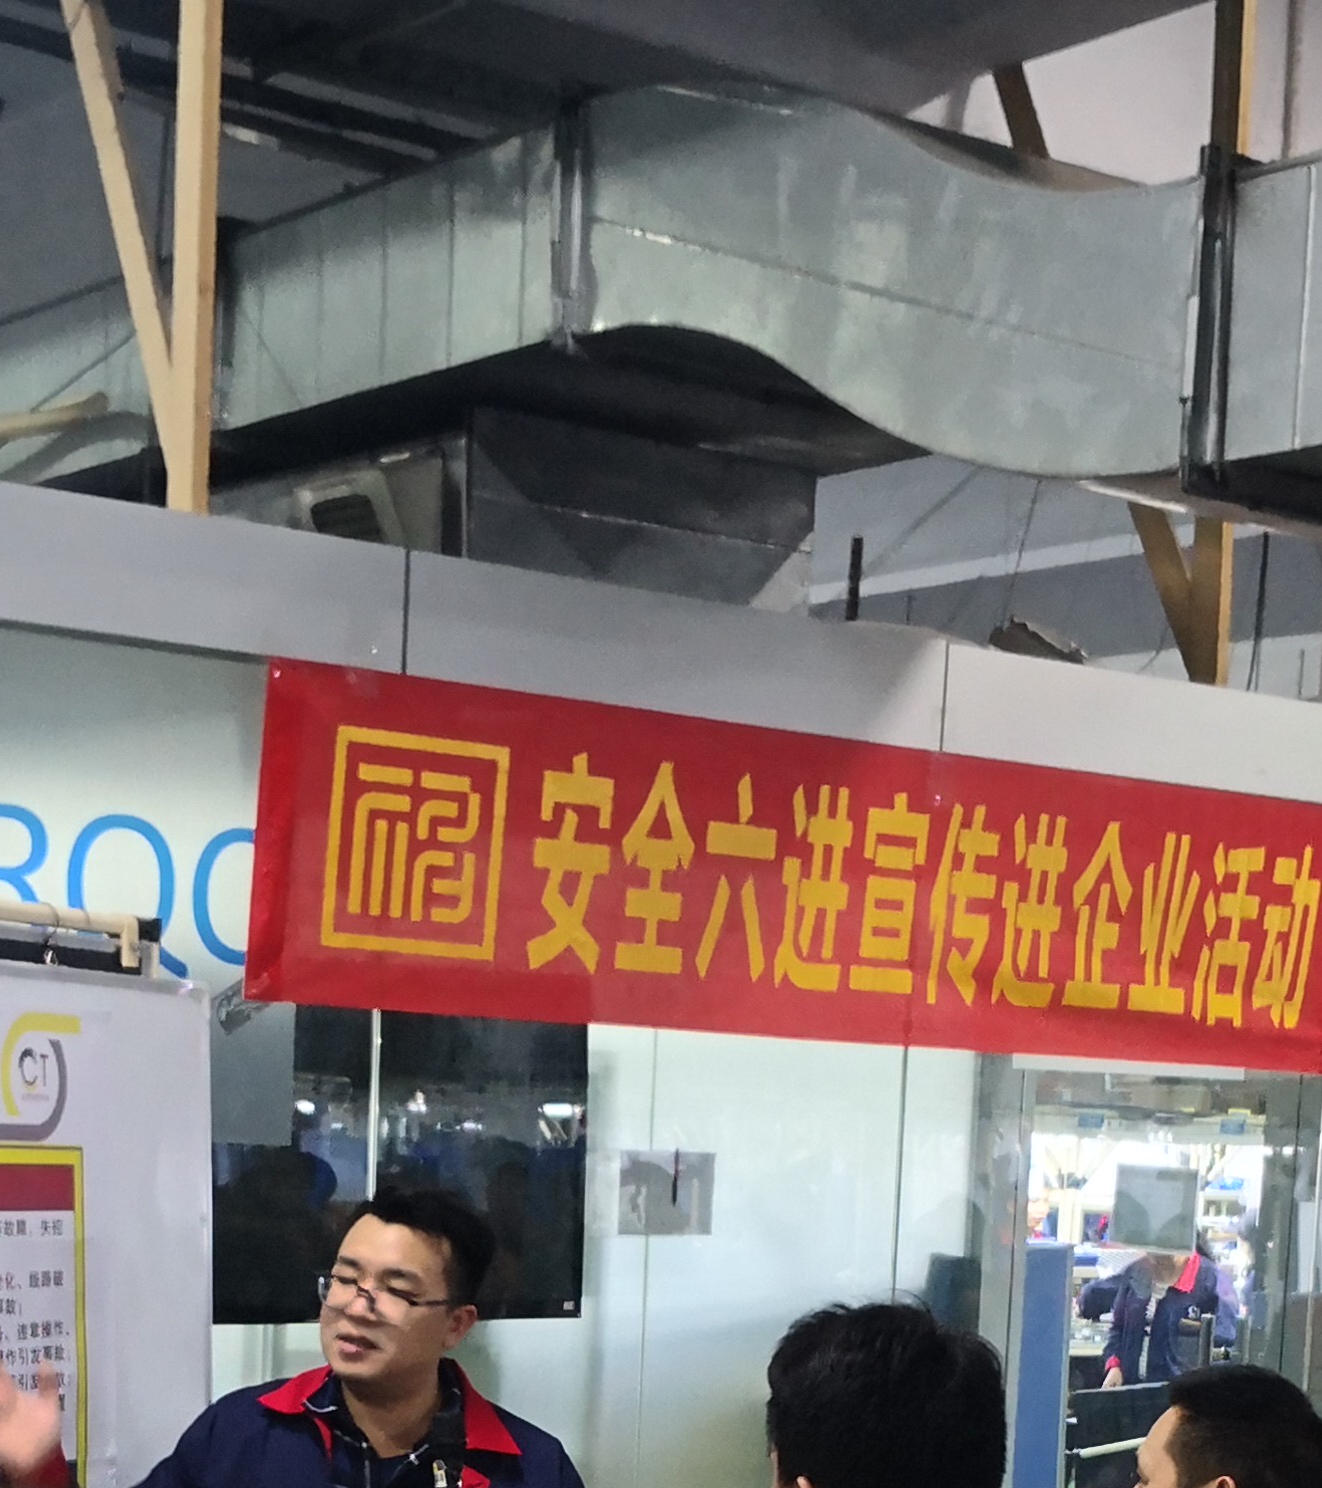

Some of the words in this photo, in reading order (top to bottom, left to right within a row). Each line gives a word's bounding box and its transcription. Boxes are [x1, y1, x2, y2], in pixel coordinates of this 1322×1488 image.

[527, 752, 1322, 1030] 安全六进宣传进企业活动
